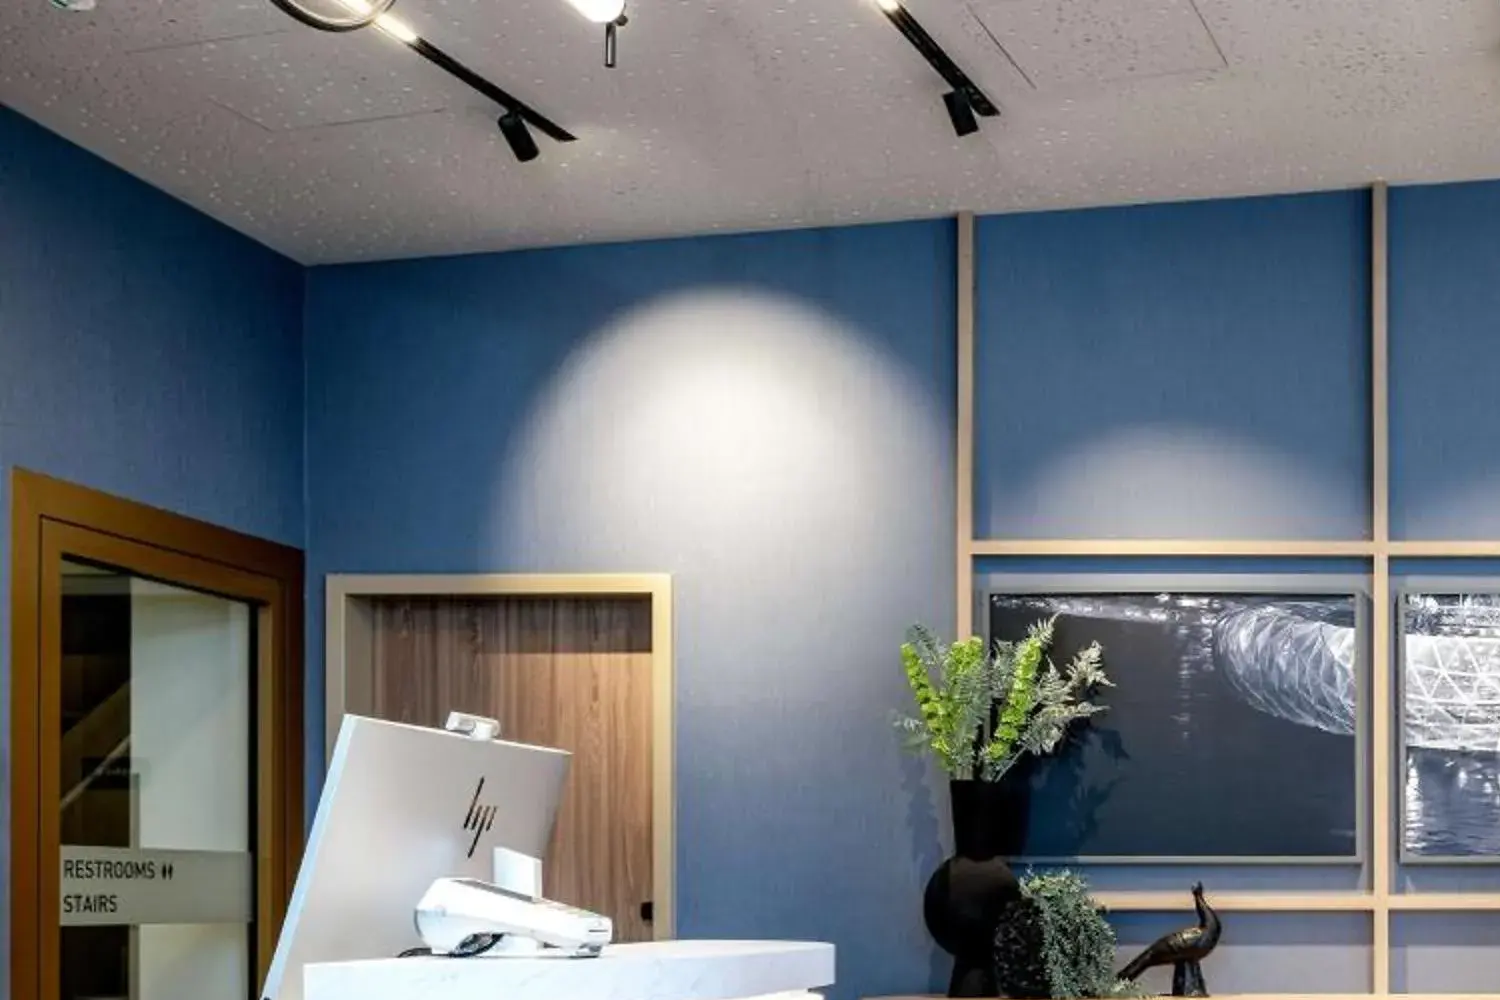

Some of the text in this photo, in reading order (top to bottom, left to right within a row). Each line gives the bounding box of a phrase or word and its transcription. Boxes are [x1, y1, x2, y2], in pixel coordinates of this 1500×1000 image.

[463, 776, 498, 858] hp
[63, 859, 155, 879] RESTROOMS
[63, 894, 118, 913] STAIRS
